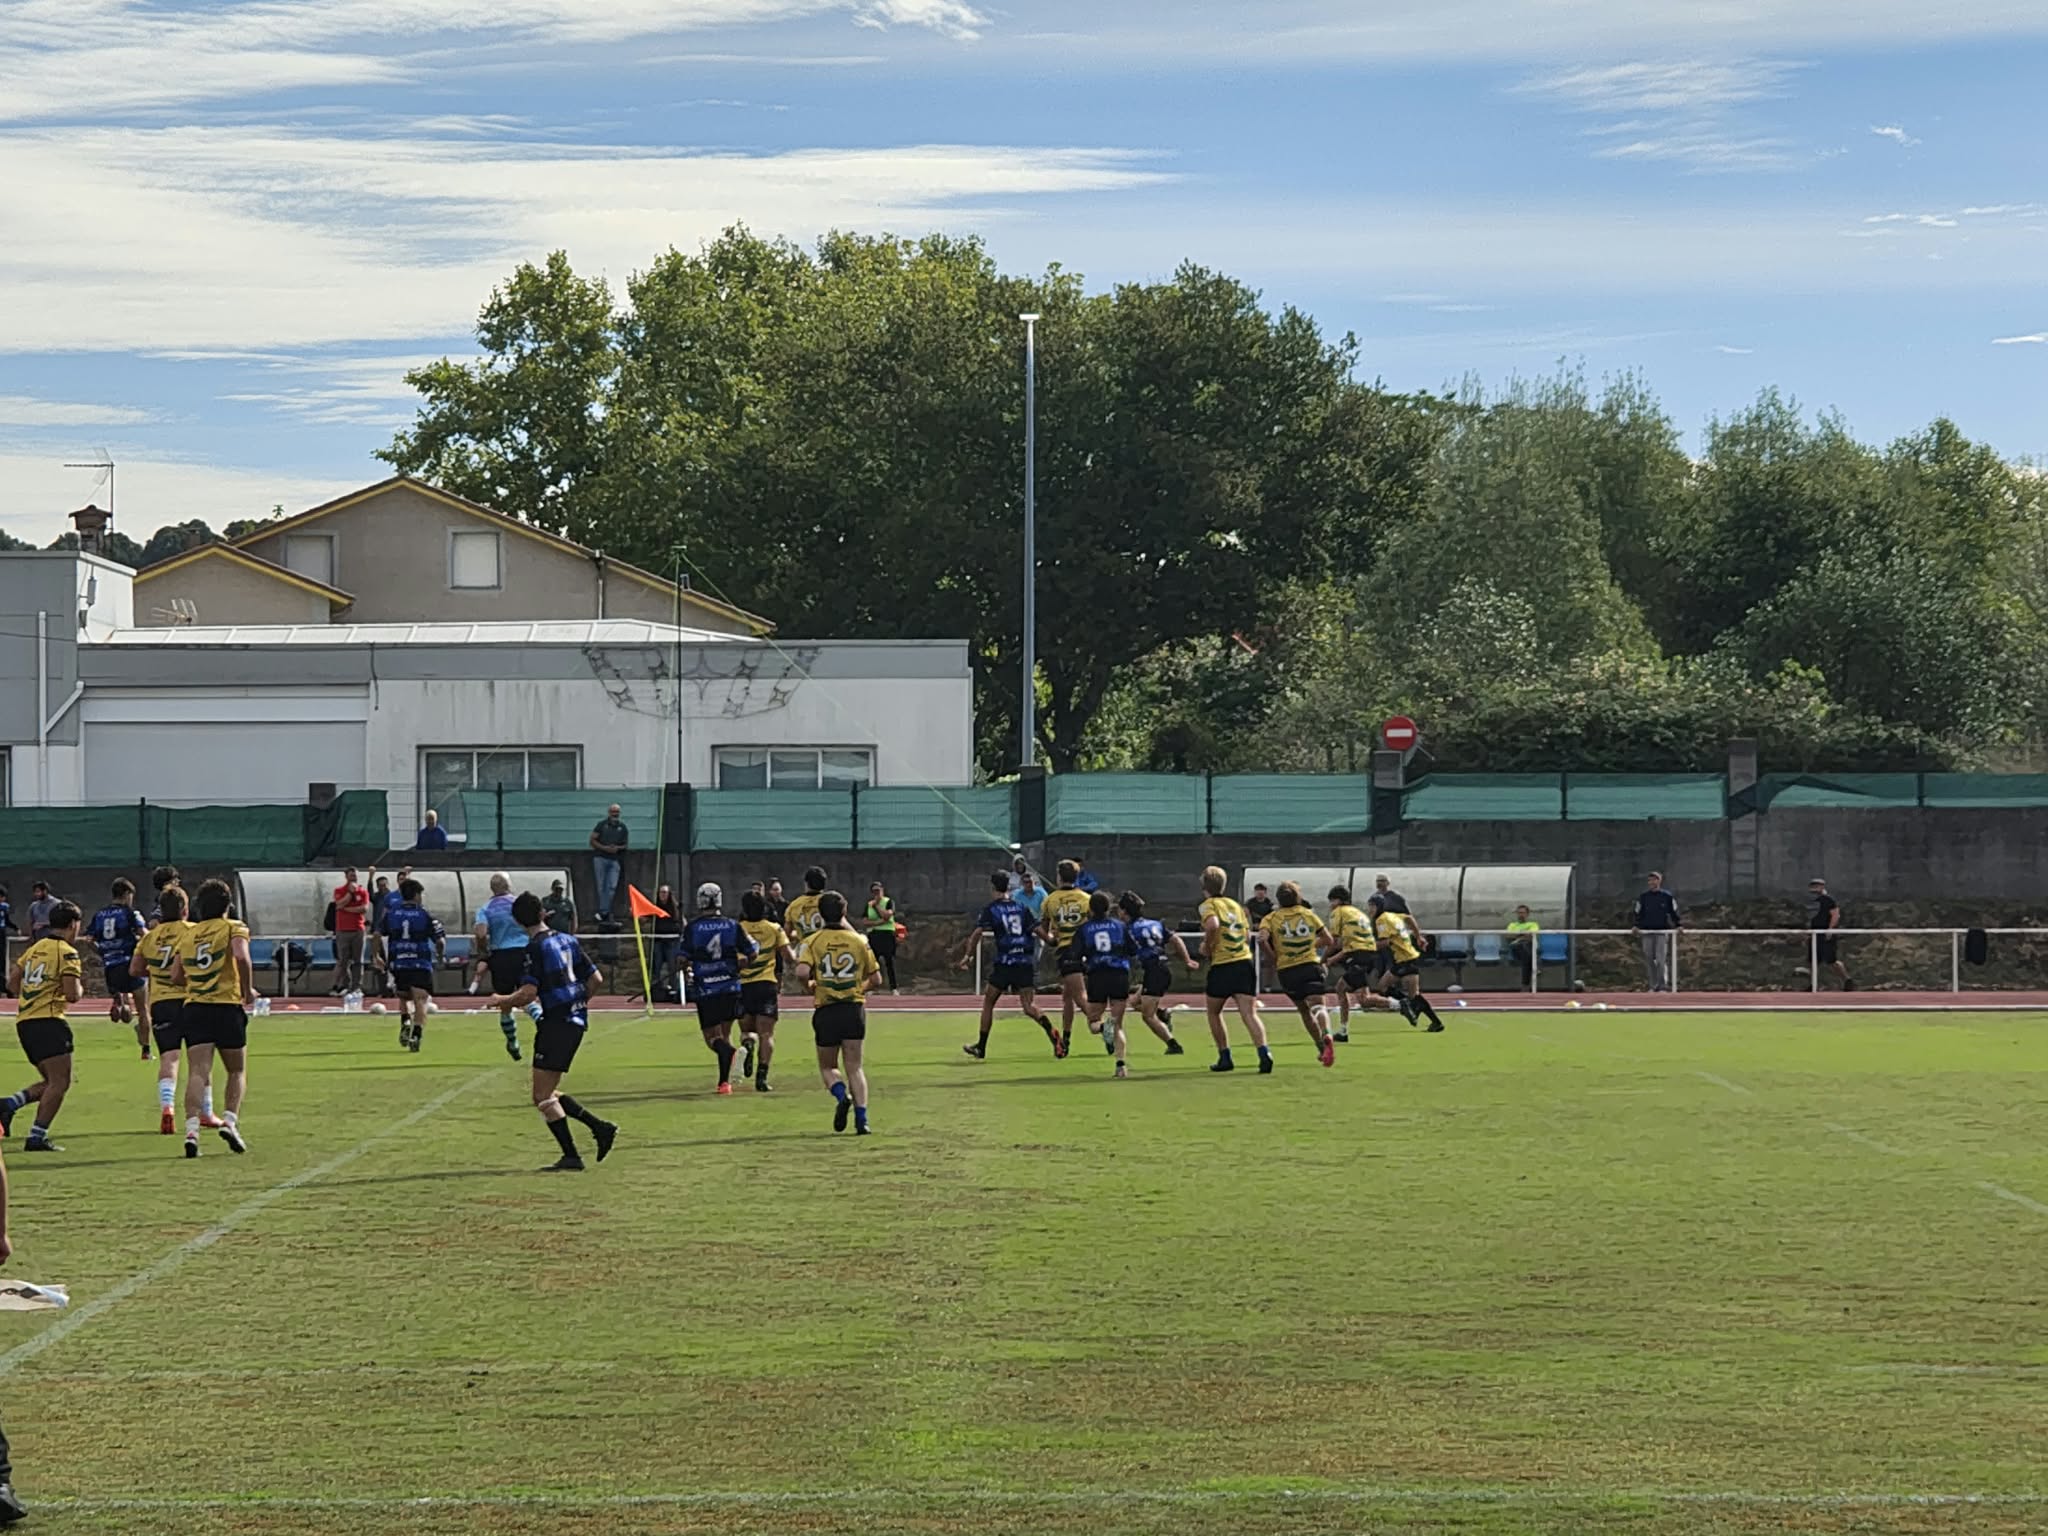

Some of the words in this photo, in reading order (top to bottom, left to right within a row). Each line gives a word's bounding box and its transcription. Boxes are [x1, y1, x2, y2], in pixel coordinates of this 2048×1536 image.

[1058, 903, 1081, 925] 15
[1282, 917, 1310, 938] 16
[159, 945, 172, 969] 7
[196, 943, 213, 969] 5
[706, 932, 722, 960] 4
[23, 960, 45, 986] 14
[821, 953, 855, 978] 12
